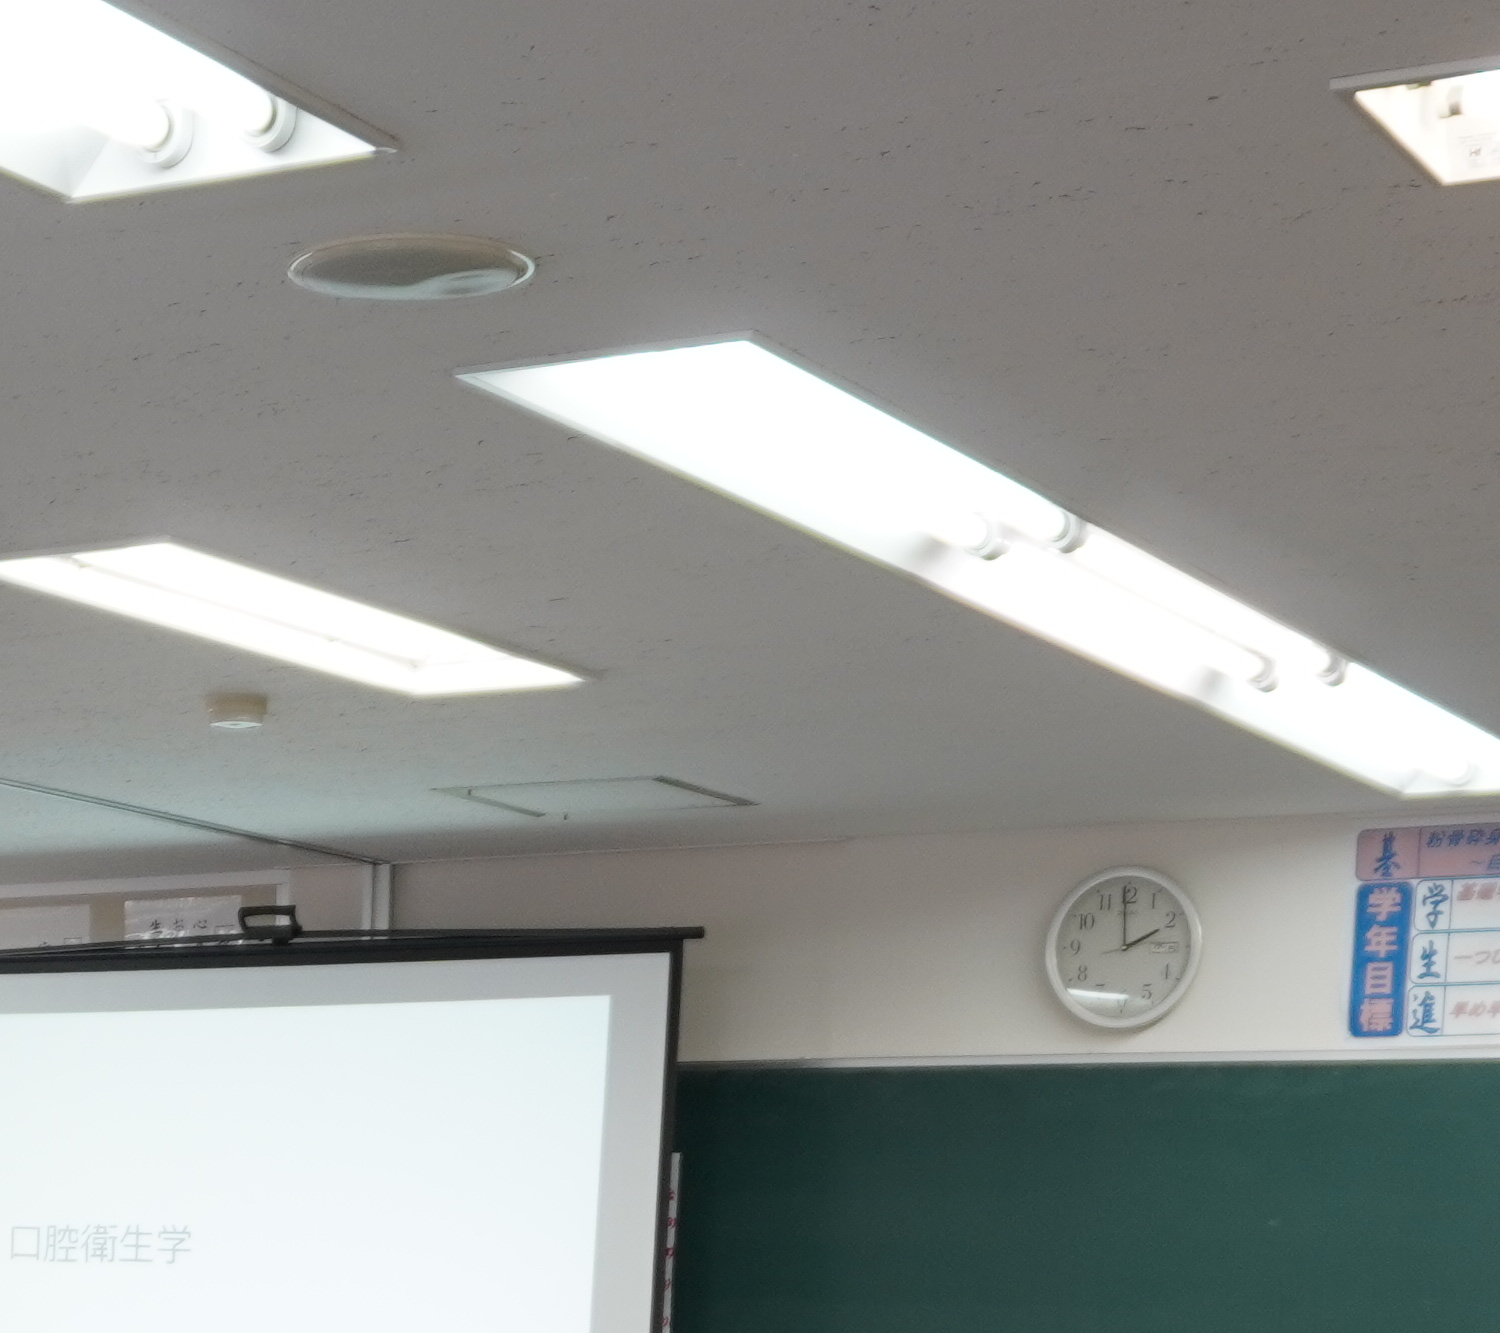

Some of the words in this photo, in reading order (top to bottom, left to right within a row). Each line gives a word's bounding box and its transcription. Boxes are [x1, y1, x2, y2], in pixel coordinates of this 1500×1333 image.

[1099, 893, 1112, 911] 11
[1422, 882, 1449, 929] 学
[1079, 913, 1095, 930] 10
[1165, 911, 1176, 928] 2
[1070, 940, 1081, 955] 9
[1358, 886, 1402, 1032] 学年目標
[1418, 940, 1441, 980] 生
[1078, 965, 1088, 981] 8
[1409, 991, 1441, 1034] 進
[11, 1224, 192, 1264] 口腔衛生学
